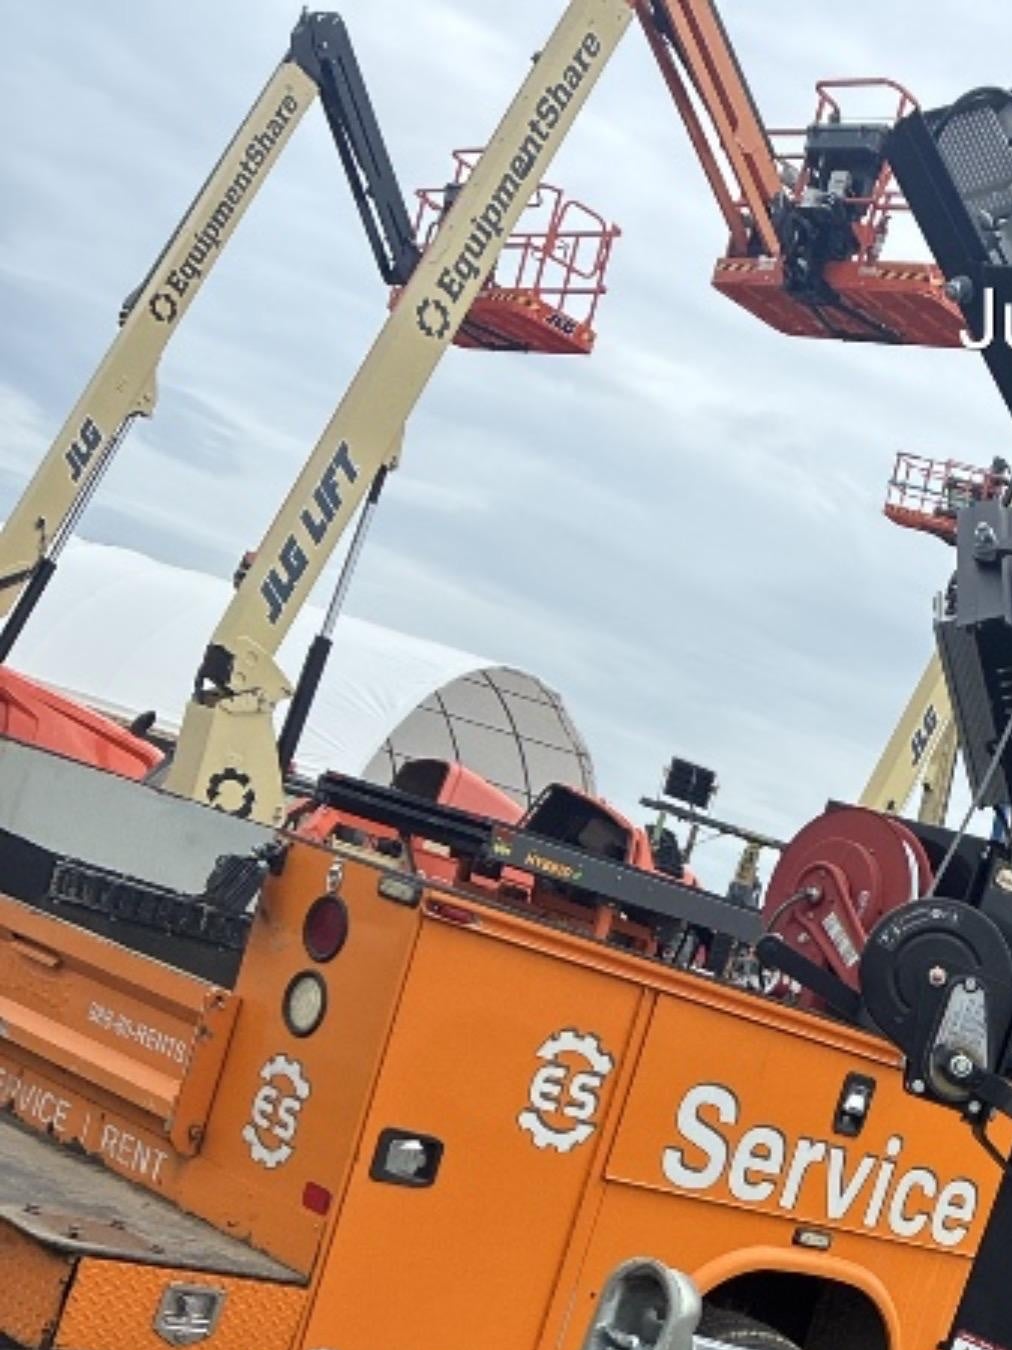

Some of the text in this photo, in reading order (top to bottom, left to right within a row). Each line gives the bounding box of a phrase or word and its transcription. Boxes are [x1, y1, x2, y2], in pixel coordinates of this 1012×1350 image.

[166, 94, 298, 297] EquipmentShare
[436, 31, 601, 304] EquipmentShare
[64, 416, 102, 483] JLG
[260, 440, 358, 625] JLG LIFT
[911, 704, 937, 767] JLG
[251, 1084, 301, 1140] ES
[529, 1063, 601, 1122] ES
[101, 1123, 169, 1185] RENT
[661, 1081, 978, 1247] Service
